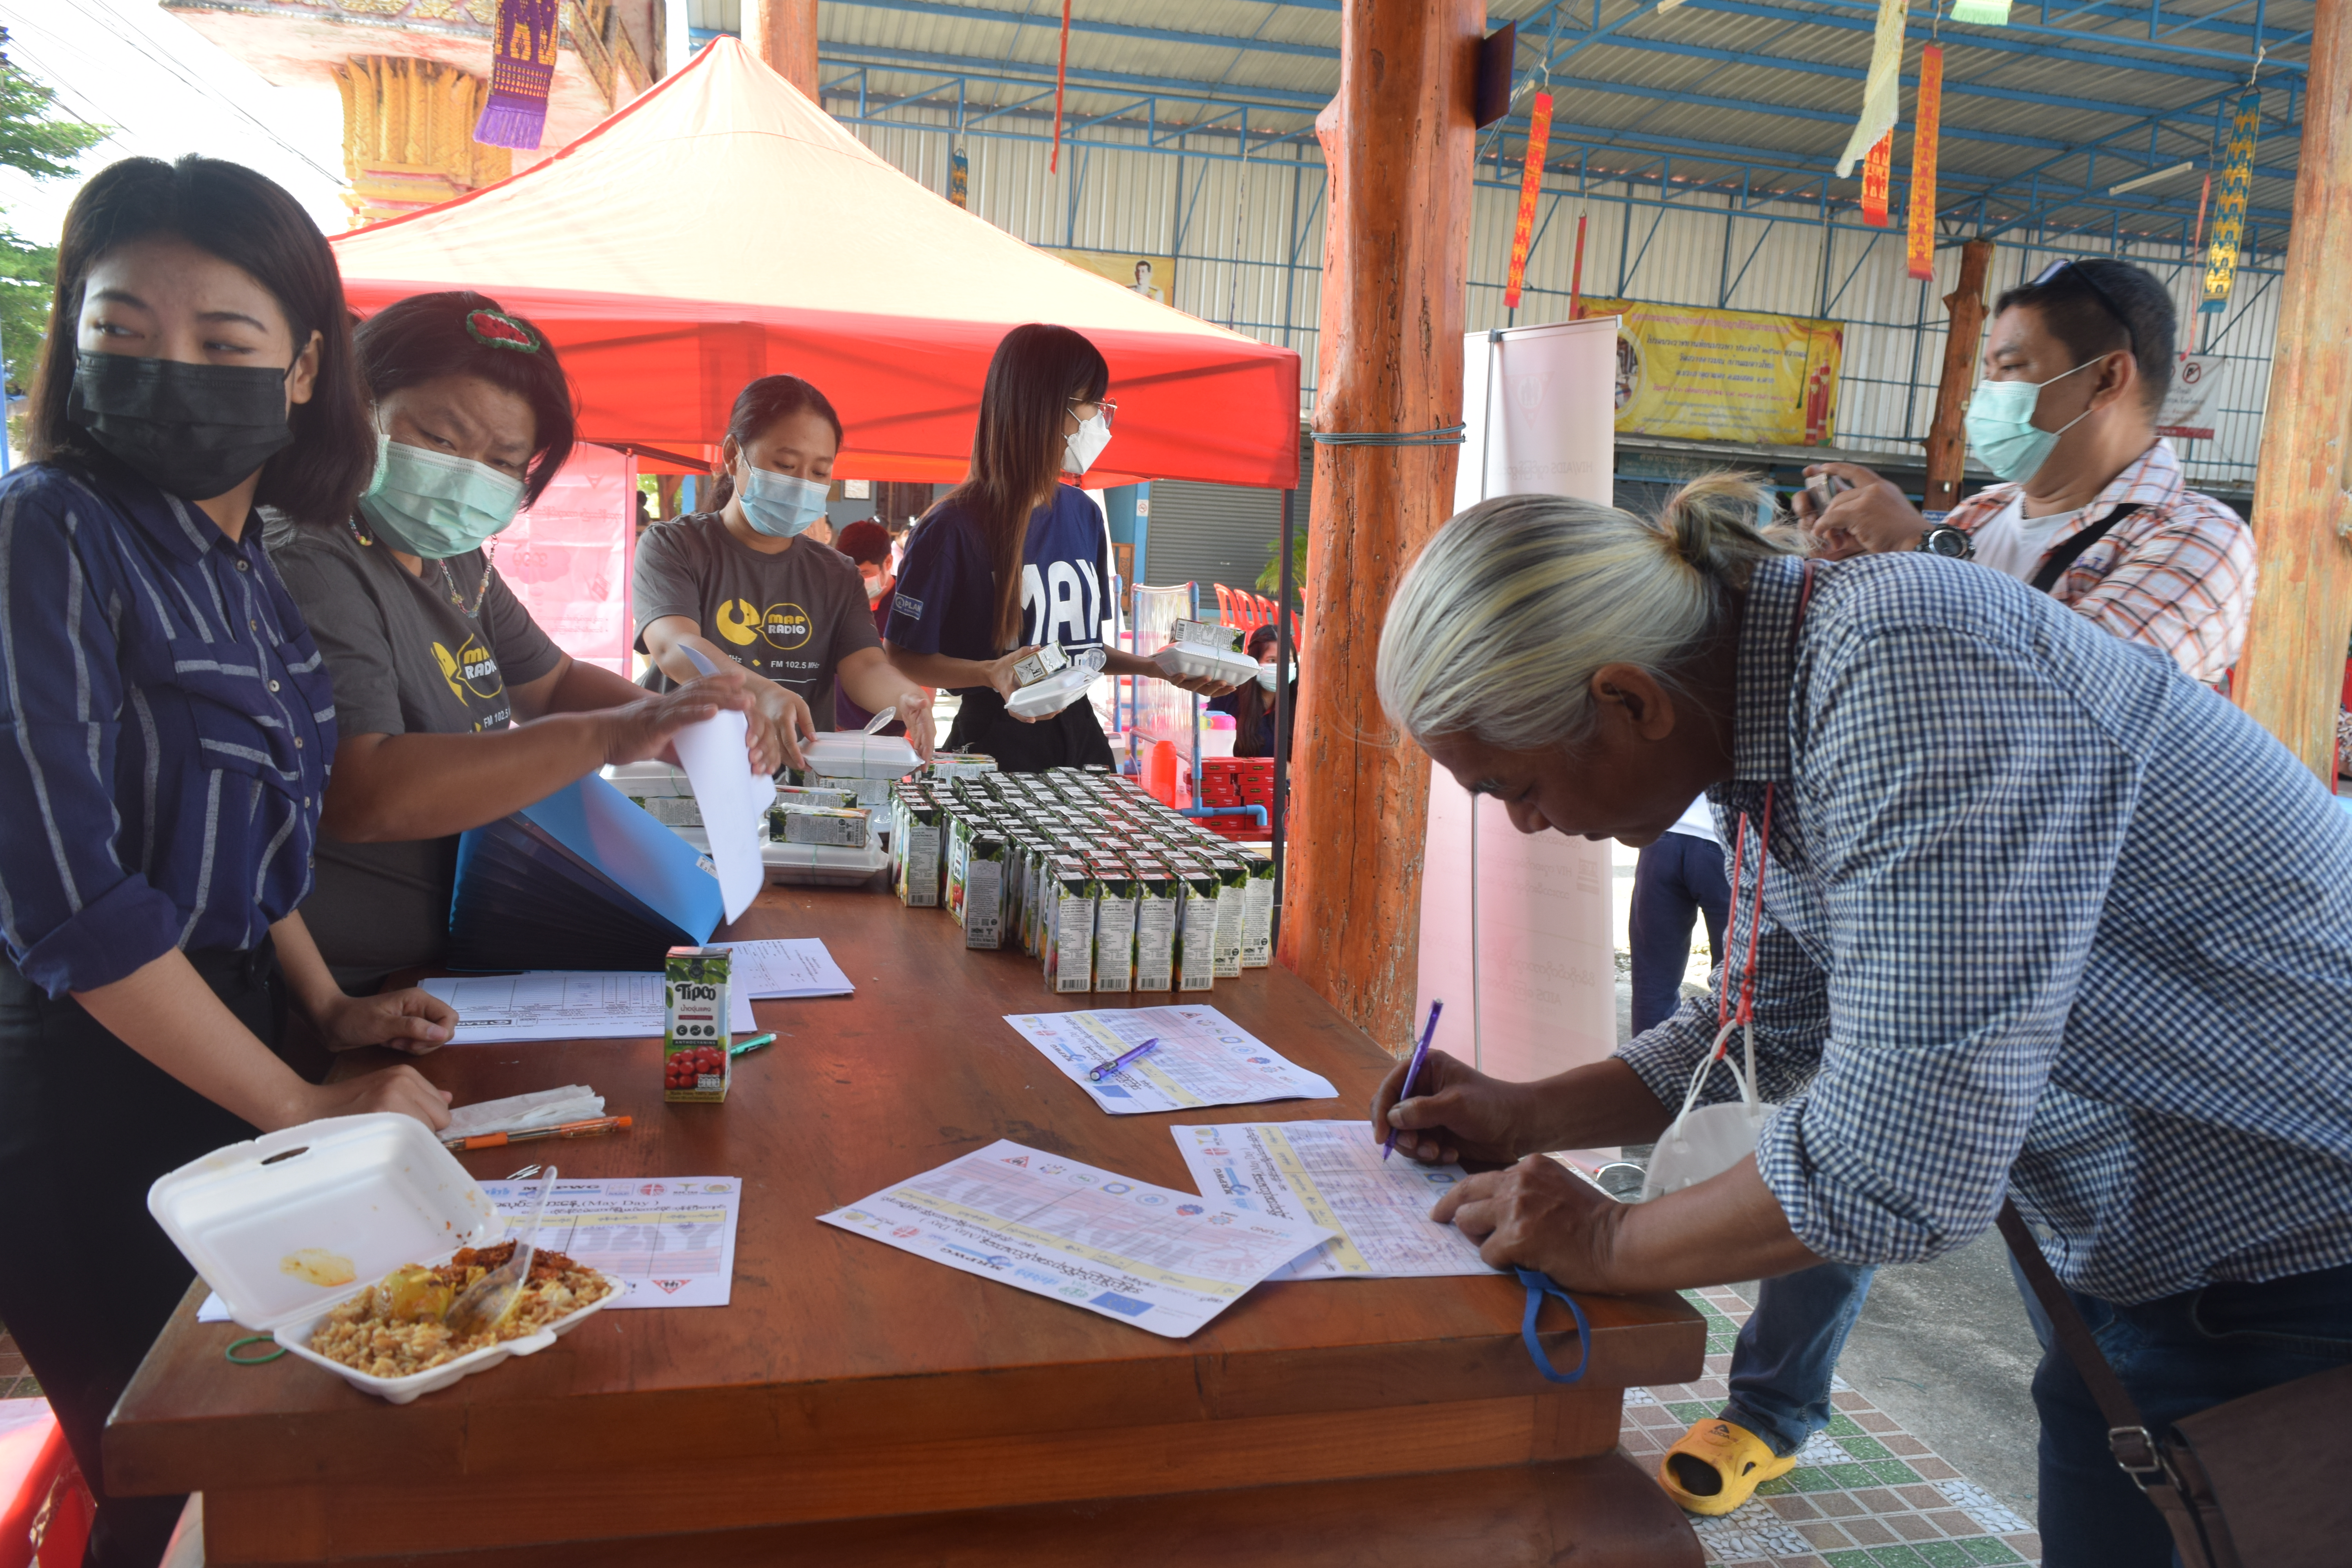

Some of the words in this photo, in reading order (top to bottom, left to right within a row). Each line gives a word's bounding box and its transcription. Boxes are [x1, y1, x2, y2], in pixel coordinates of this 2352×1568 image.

[905, 600, 921, 612] PLAN
[768, 613, 805, 624] MAP
[768, 624, 806, 634] RADIO
[464, 645, 489, 664] MA
[785, 661, 807, 669] 102.5
[483, 714, 494, 728] FM
[494, 709, 510, 722] 102.5
[675, 983, 716, 1001] Tipco
[1213, 1168, 1233, 1195] MRPWG
[937, 1247, 1007, 1271] MRPWG
